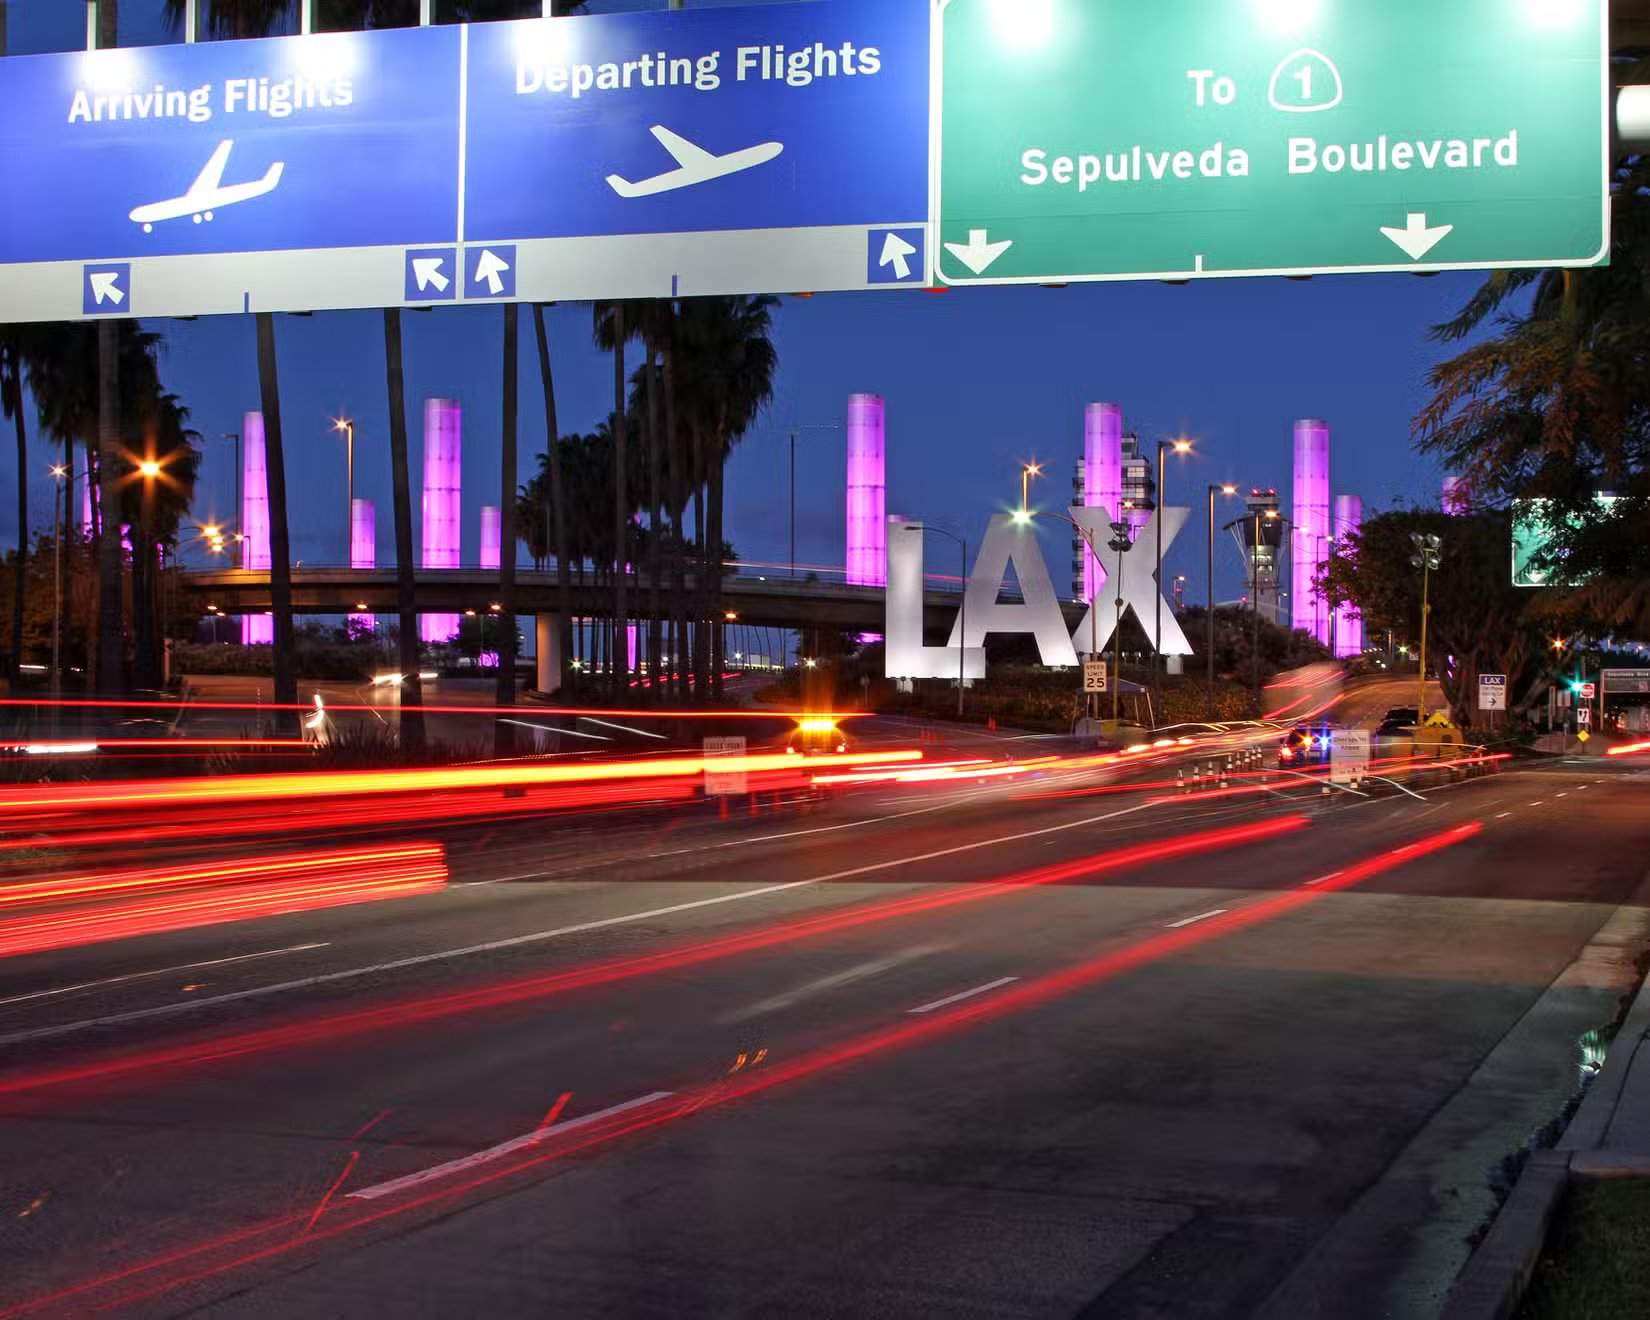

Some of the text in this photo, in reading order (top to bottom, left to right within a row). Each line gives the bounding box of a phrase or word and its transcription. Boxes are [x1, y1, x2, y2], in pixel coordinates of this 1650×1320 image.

[514, 42, 881, 98] Departing Flights
[1187, 65, 1312, 107] To 1
[68, 77, 353, 123] Arriving Flights
[1020, 129, 1518, 192] Sepulveda Boulevard
[885, 506, 1194, 679] LAX
[1086, 677, 1105, 688] 25
